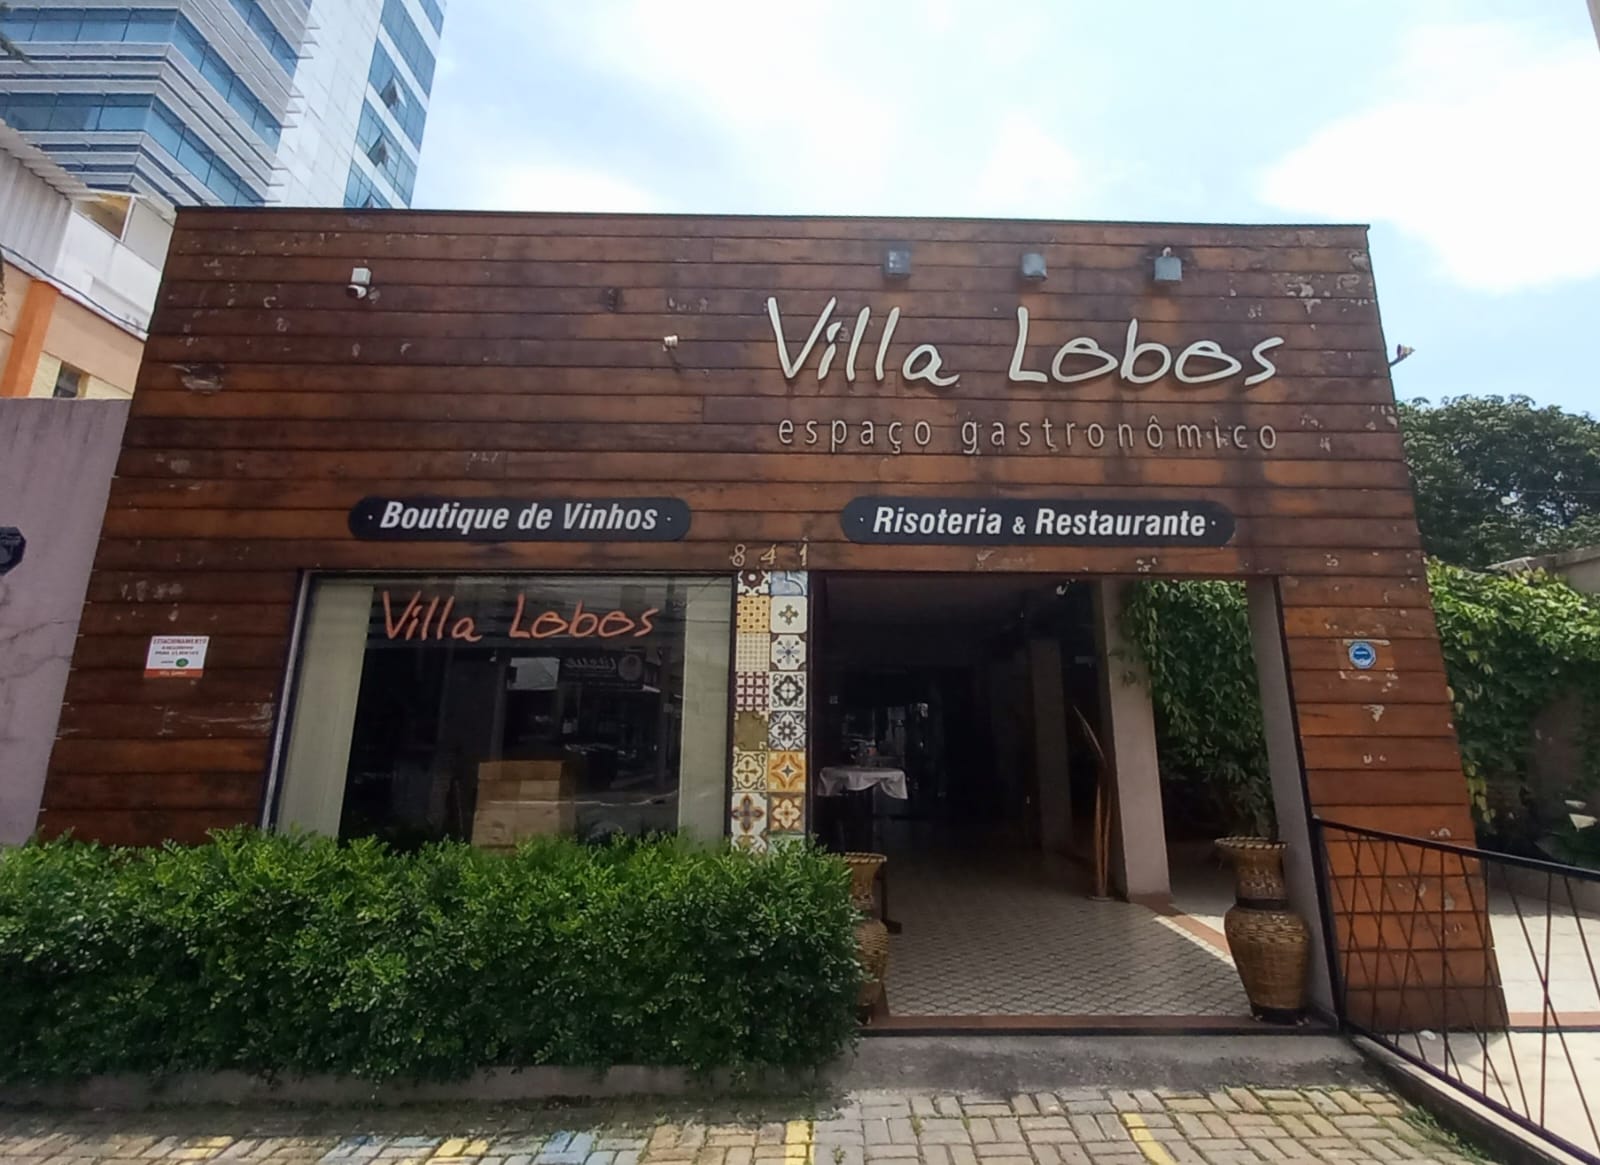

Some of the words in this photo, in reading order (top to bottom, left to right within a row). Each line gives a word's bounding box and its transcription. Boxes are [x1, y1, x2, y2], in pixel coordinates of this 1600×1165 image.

[767, 296, 960, 386] Villa
[1008, 306, 1285, 386] Lobos
[778, 419, 932, 454] espaço
[961, 415, 1277, 455] gastronômico
[380, 501, 509, 534] Boutique
[518, 503, 552, 530] de
[563, 503, 658, 530] Vinhos
[873, 506, 1002, 535] Risoteria
[1012, 516, 1026, 535] &
[1035, 508, 1206, 536] Restaurante
[383, 590, 483, 642] Villa
[509, 592, 658, 638] Lobos
